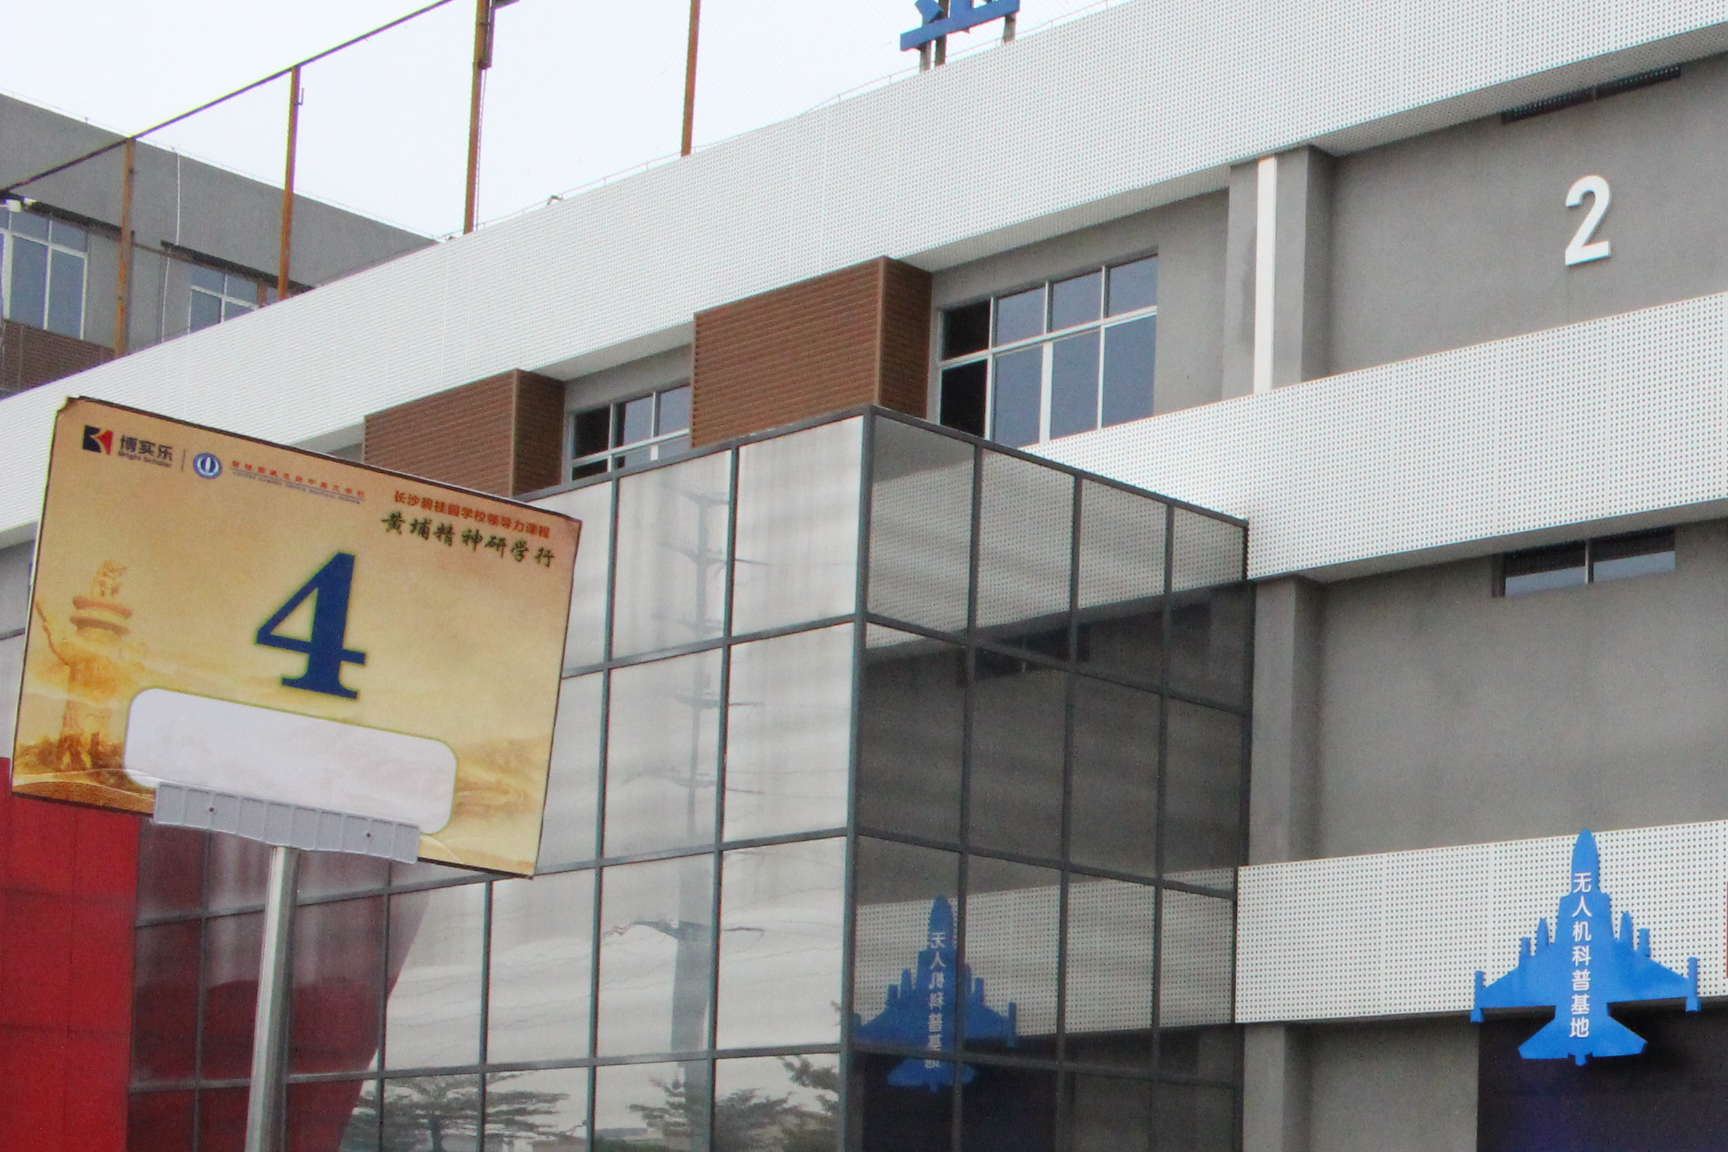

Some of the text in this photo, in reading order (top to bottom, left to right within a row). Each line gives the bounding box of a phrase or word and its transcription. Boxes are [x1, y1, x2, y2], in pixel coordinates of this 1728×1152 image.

[1564, 174, 1612, 266] 2
[118, 434, 173, 461] 博实乐
[255, 551, 368, 699] 4
[1568, 871, 1593, 1039] 无人机科普基地
